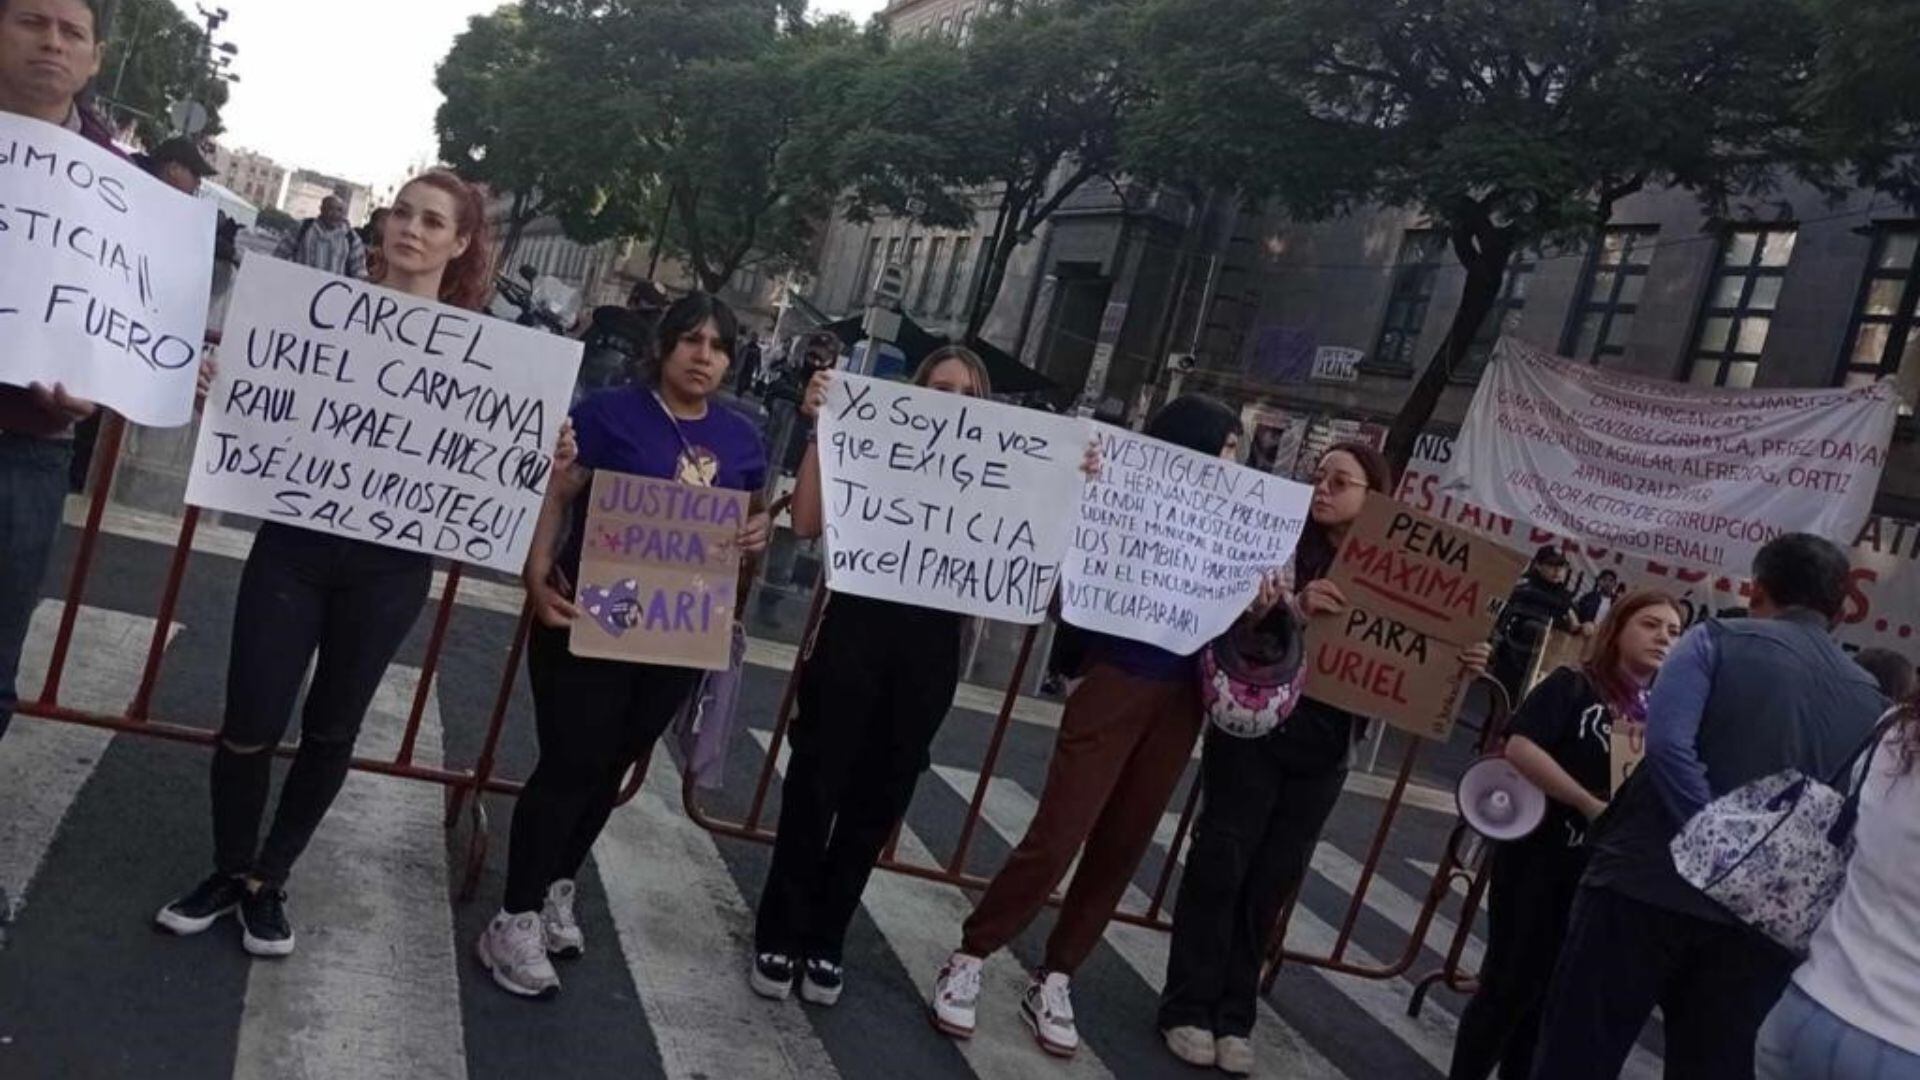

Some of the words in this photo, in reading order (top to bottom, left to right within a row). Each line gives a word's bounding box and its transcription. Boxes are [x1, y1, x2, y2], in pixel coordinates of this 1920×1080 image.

[44, 284, 195, 371] FUERO
[309, 281, 492, 370] CARCEL
[247, 327, 355, 383] URIEL
[377, 360, 544, 449] CARMONA
[839, 381, 877, 421] Yo
[889, 396, 948, 450] Soy
[956, 406, 983, 442] la
[225, 379, 300, 422] RAUL
[312, 397, 422, 456] ISRAEL
[428, 427, 497, 481] HDEZ
[206, 431, 293, 478] JOSÉ
[285, 452, 352, 490] LUIS
[362, 468, 526, 552] URIOSTEGUI
[832, 431, 879, 468] que
[888, 443, 1011, 493] EXIGE
[1244, 478, 1265, 505] A
[270, 490, 492, 560] SALGADO
[600, 477, 742, 524] JUSTICIA
[832, 477, 1035, 552] JUSTICIA
[1154, 500, 1163, 519] Y
[1166, 506, 1176, 523] A
[1549, 481, 1583, 501] POR
[1583, 492, 1632, 517] ACTOS
[1634, 503, 1658, 521] DE
[622, 523, 706, 564] PARA
[1075, 526, 1109, 555] LOS
[1083, 557, 1107, 577] EN
[1115, 564, 1132, 583] EL
[1386, 511, 1469, 573] PENA
[918, 547, 977, 598] PARA
[644, 586, 712, 633] ARI
[1345, 608, 1427, 664] PARA
[1317, 642, 1407, 704] URIEL
